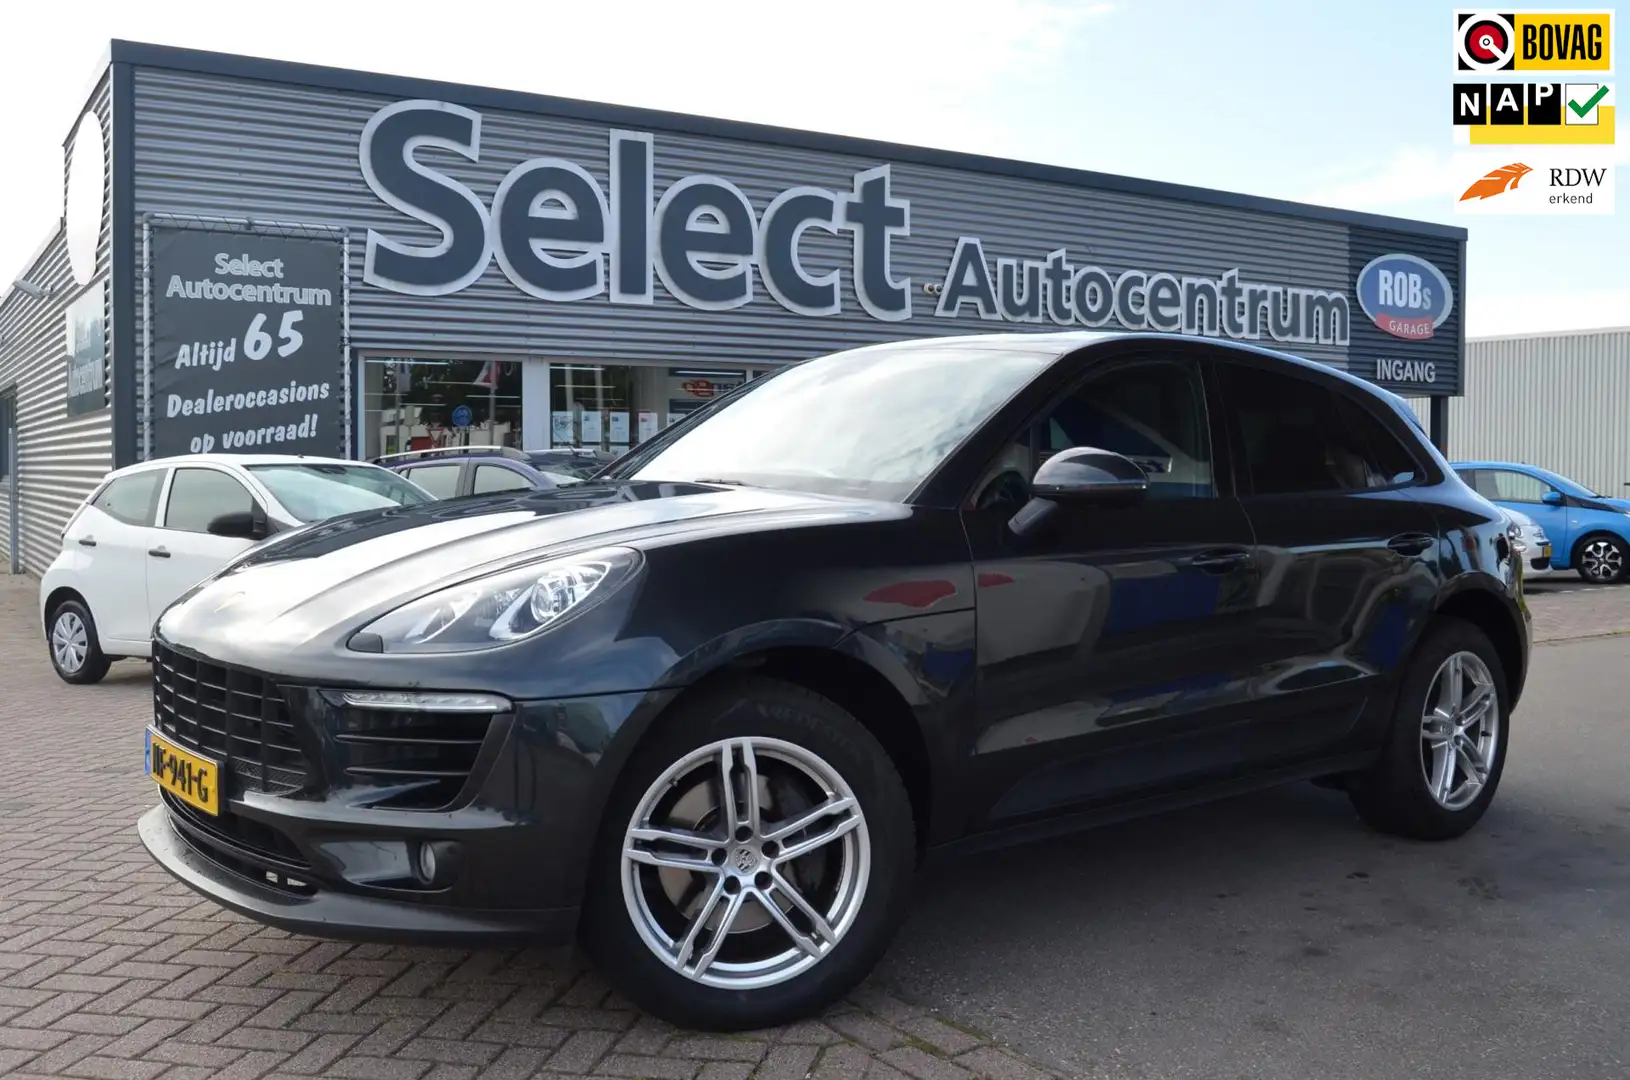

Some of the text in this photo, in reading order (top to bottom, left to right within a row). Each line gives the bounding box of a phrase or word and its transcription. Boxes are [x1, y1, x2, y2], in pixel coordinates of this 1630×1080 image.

[359, 99, 912, 322] Select
[214, 253, 284, 279] Select
[166, 275, 332, 306] Autocentrum
[935, 236, 1350, 347] Autocentrum
[1378, 269, 1432, 311] ROBs
[175, 310, 304, 371] Altijd 65
[1389, 320, 1431, 335] GARAGE
[1376, 358, 1436, 383] INGANG
[167, 380, 330, 418] Dealeroccasions
[190, 414, 318, 455] op voorraad!
